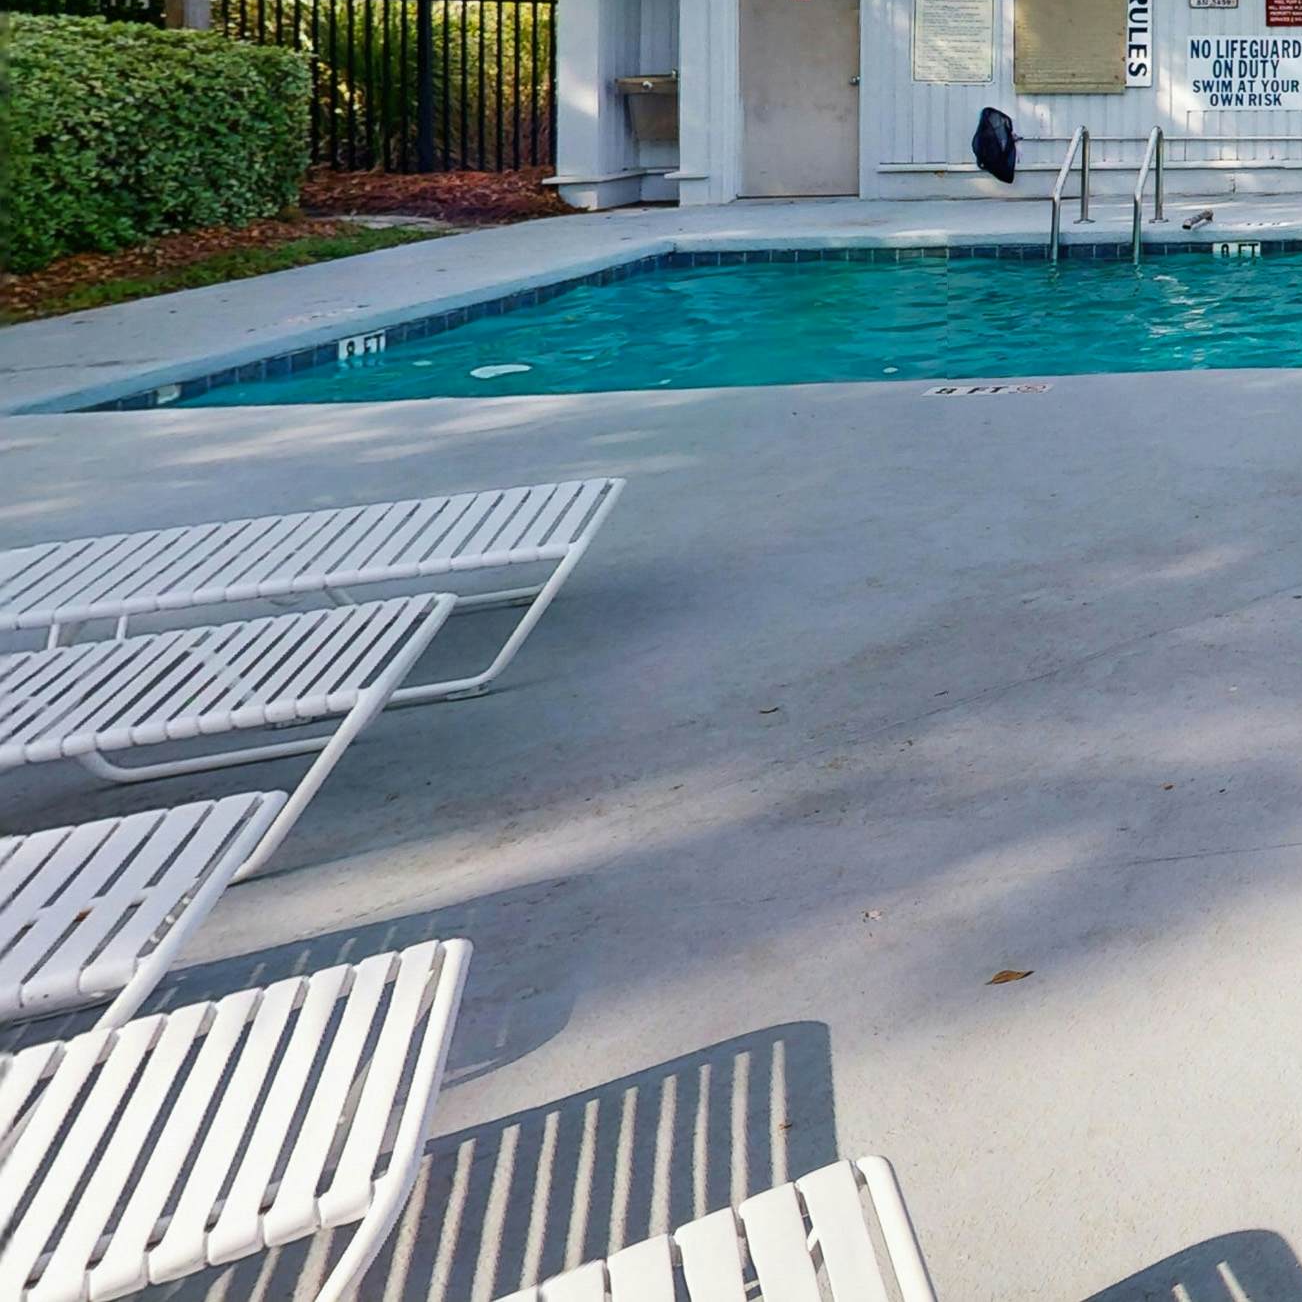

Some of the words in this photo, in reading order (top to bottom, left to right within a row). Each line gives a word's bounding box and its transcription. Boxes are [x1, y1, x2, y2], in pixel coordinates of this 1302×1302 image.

[1190, 39, 1211, 59] NO
[1216, 39, 1302, 59] LIFEGUARD
[1213, 59, 1233, 79] ON
[1239, 59, 1280, 79] DUTY
[1193, 80, 1233, 93] SWIM
[1238, 80, 1256, 93] AT
[1261, 80, 1300, 93] YOUR
[1210, 93, 1243, 107] OWN
[1248, 93, 1282, 107] RISK
[1238, 243, 1259, 259] FT
[363, 333, 383, 355] FT
[967, 385, 1009, 395] FT
